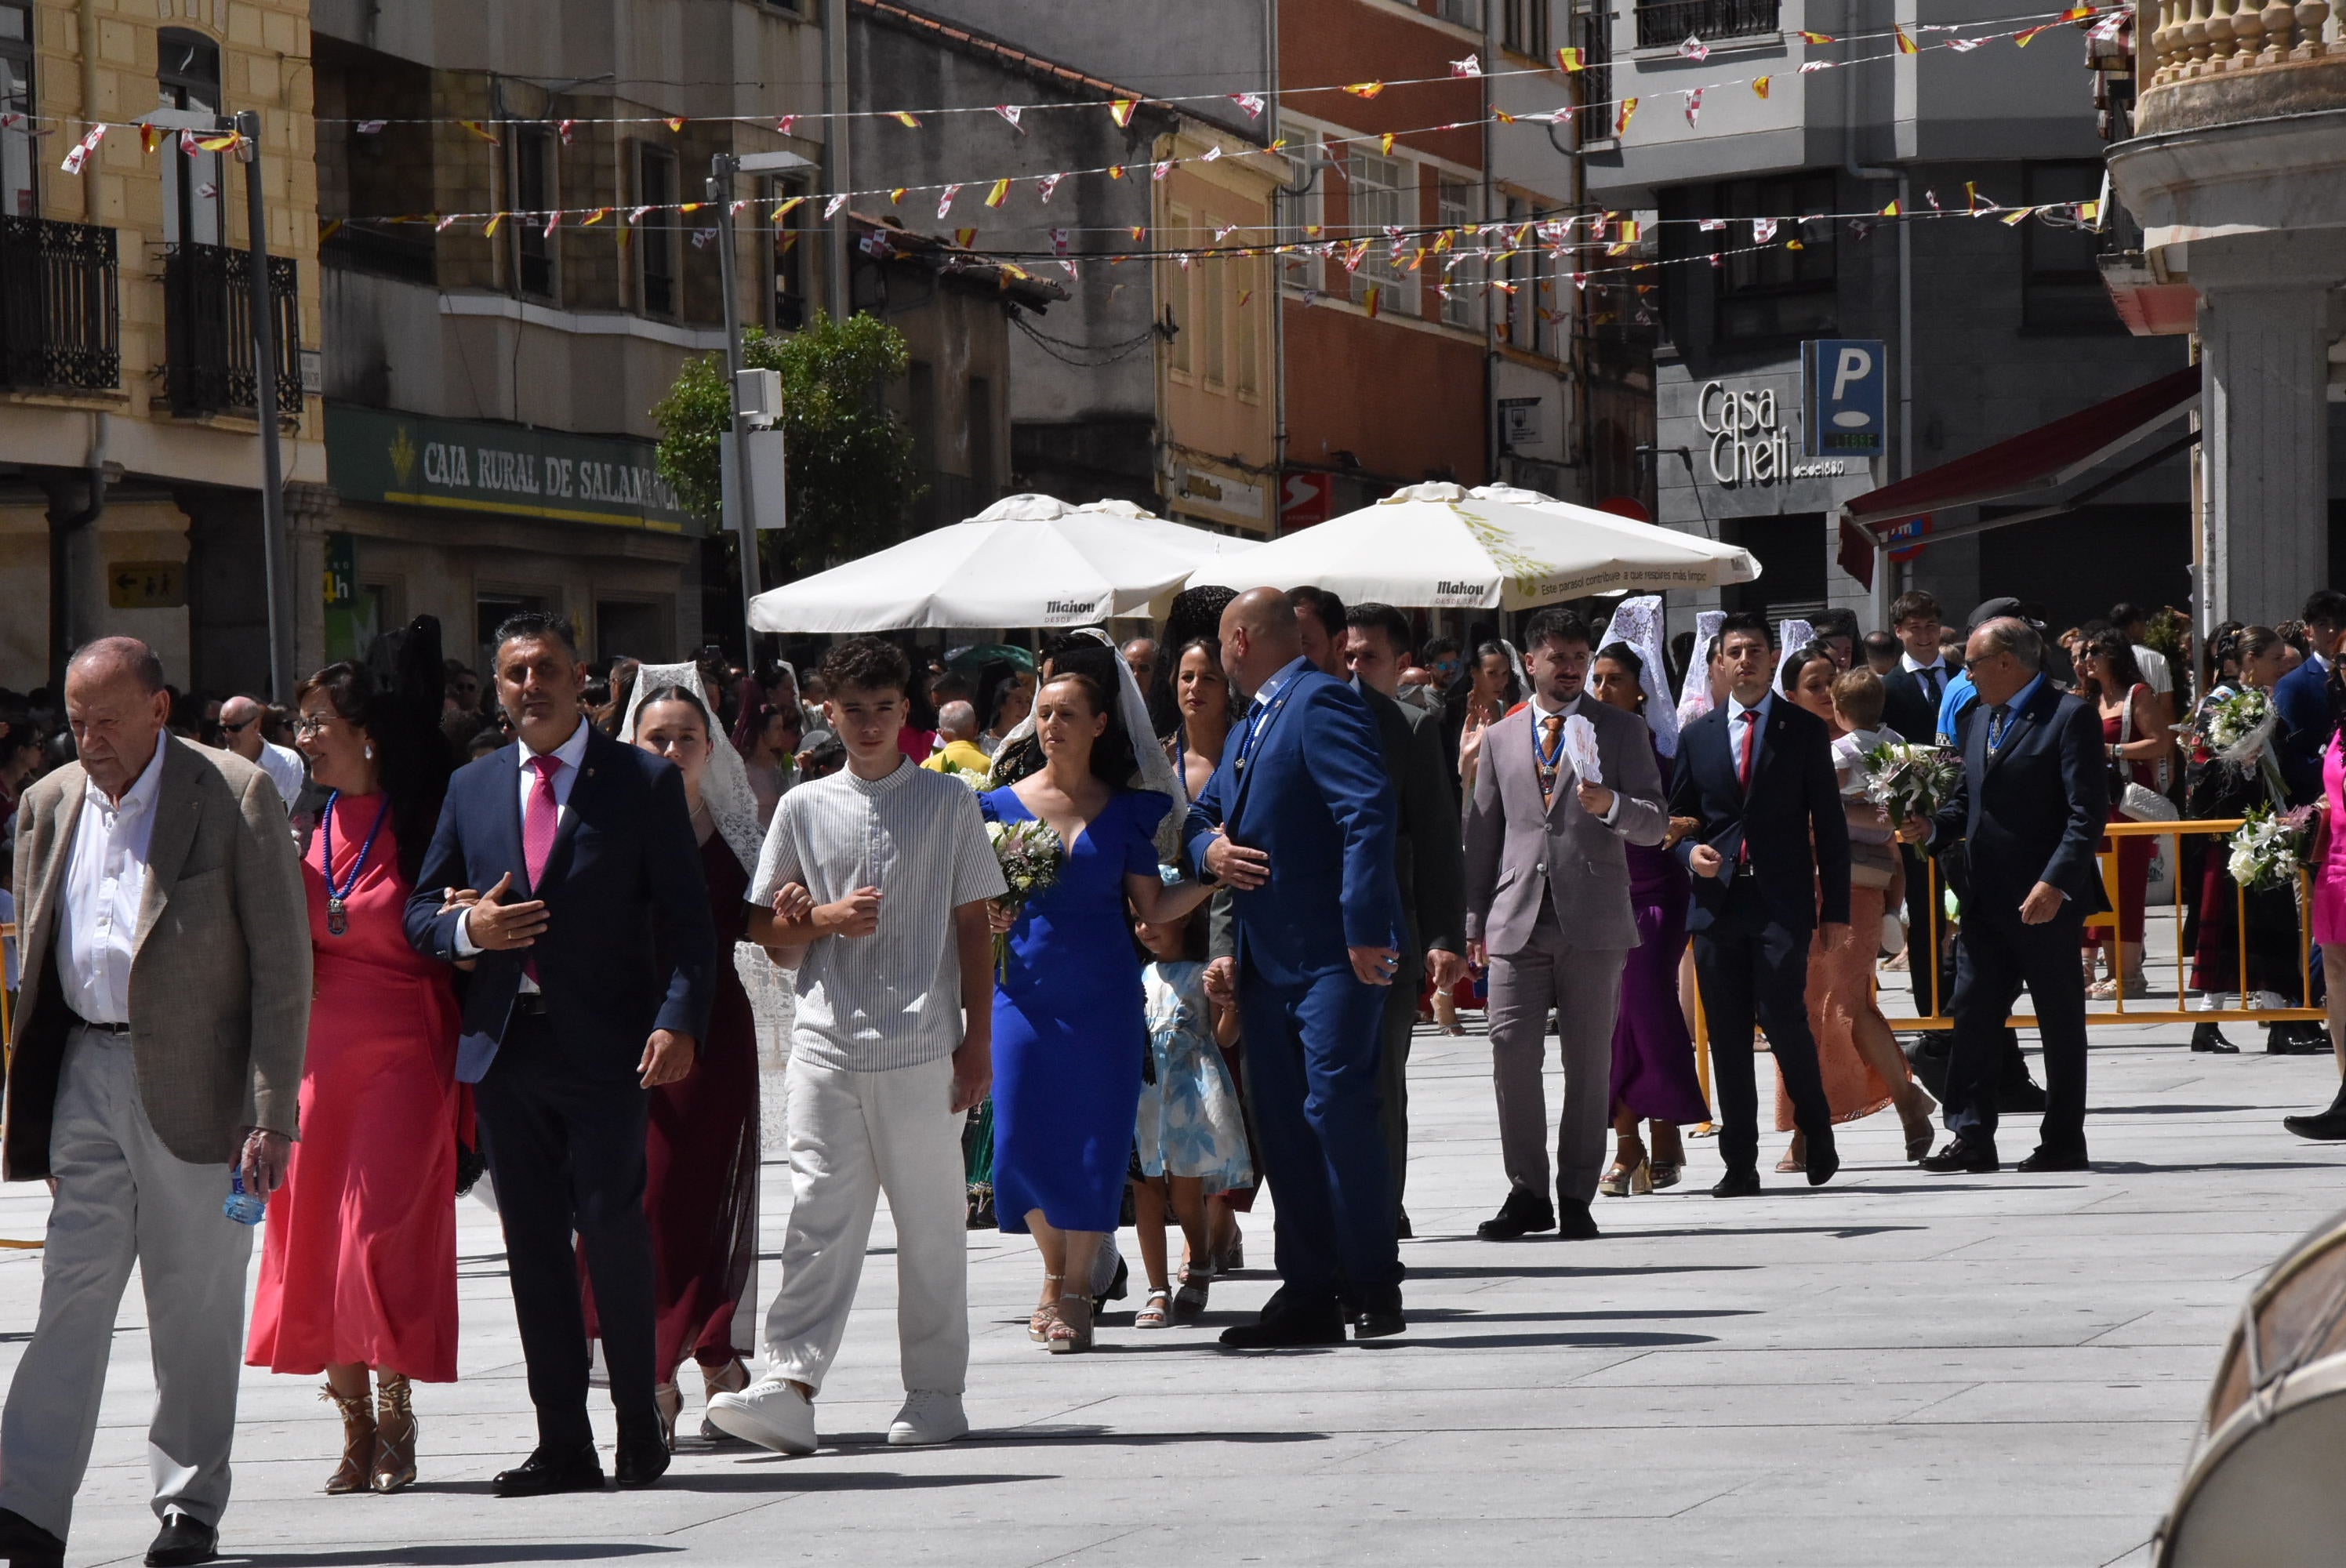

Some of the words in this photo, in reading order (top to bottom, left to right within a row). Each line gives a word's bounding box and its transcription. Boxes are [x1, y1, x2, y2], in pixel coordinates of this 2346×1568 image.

[1832, 348, 1871, 400] P
[1698, 381, 1774, 433] Casa
[1710, 426, 1788, 482] Cheti
[1836, 434, 1874, 448] LIBRE
[423, 442, 470, 488] CAJA
[477, 448, 539, 494] RURAL
[546, 456, 572, 498] DE
[1436, 580, 1484, 595] Mahou
[1542, 584, 1557, 596] Este
[1559, 576, 1584, 593] parasol
[1585, 572, 1621, 586] contribuye
[1624, 572, 1629, 580] a
[1630, 571, 1643, 582] que
[1644, 570, 1671, 582] respires
[1672, 569, 1687, 580] más
[1047, 600, 1095, 614] Mahou
